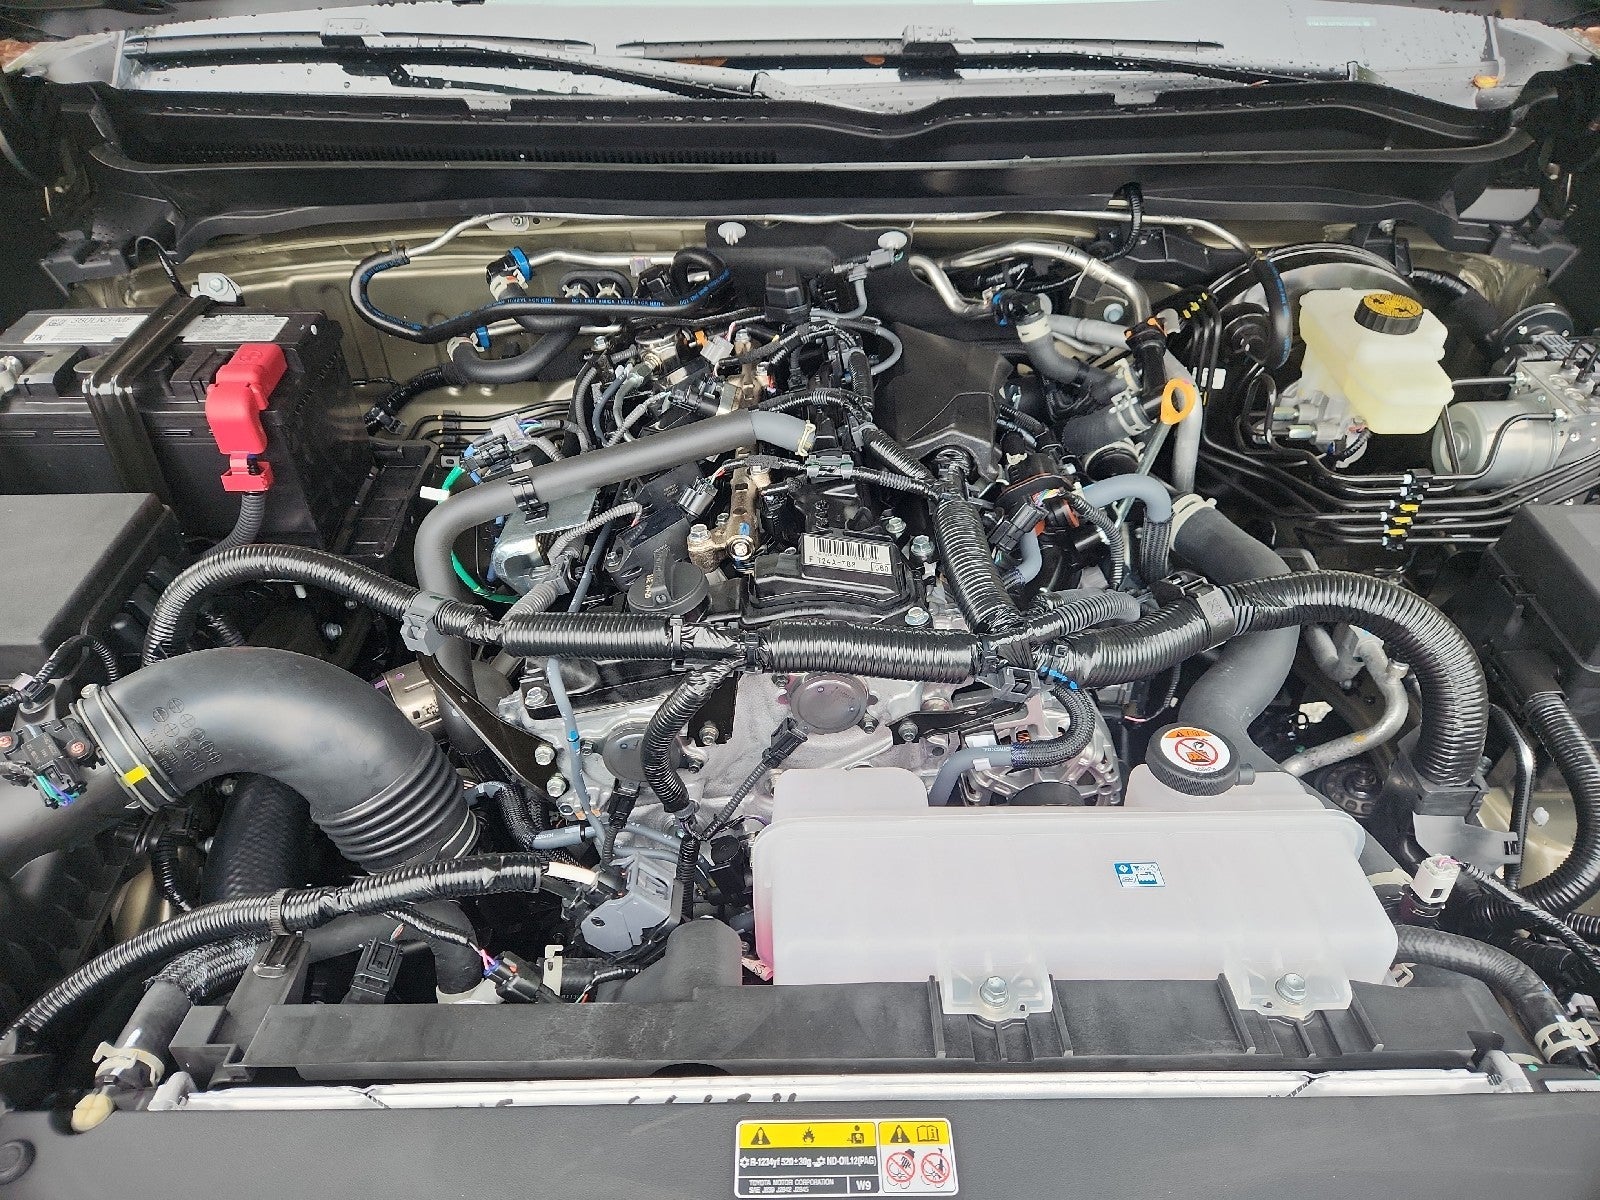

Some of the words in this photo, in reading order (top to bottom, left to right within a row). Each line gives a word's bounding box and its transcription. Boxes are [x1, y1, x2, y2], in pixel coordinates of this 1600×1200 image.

[749, 1179, 772, 1187] TOYOTA
[794, 1178, 835, 1186] CORPORATION
[855, 1180, 872, 1191] W9
